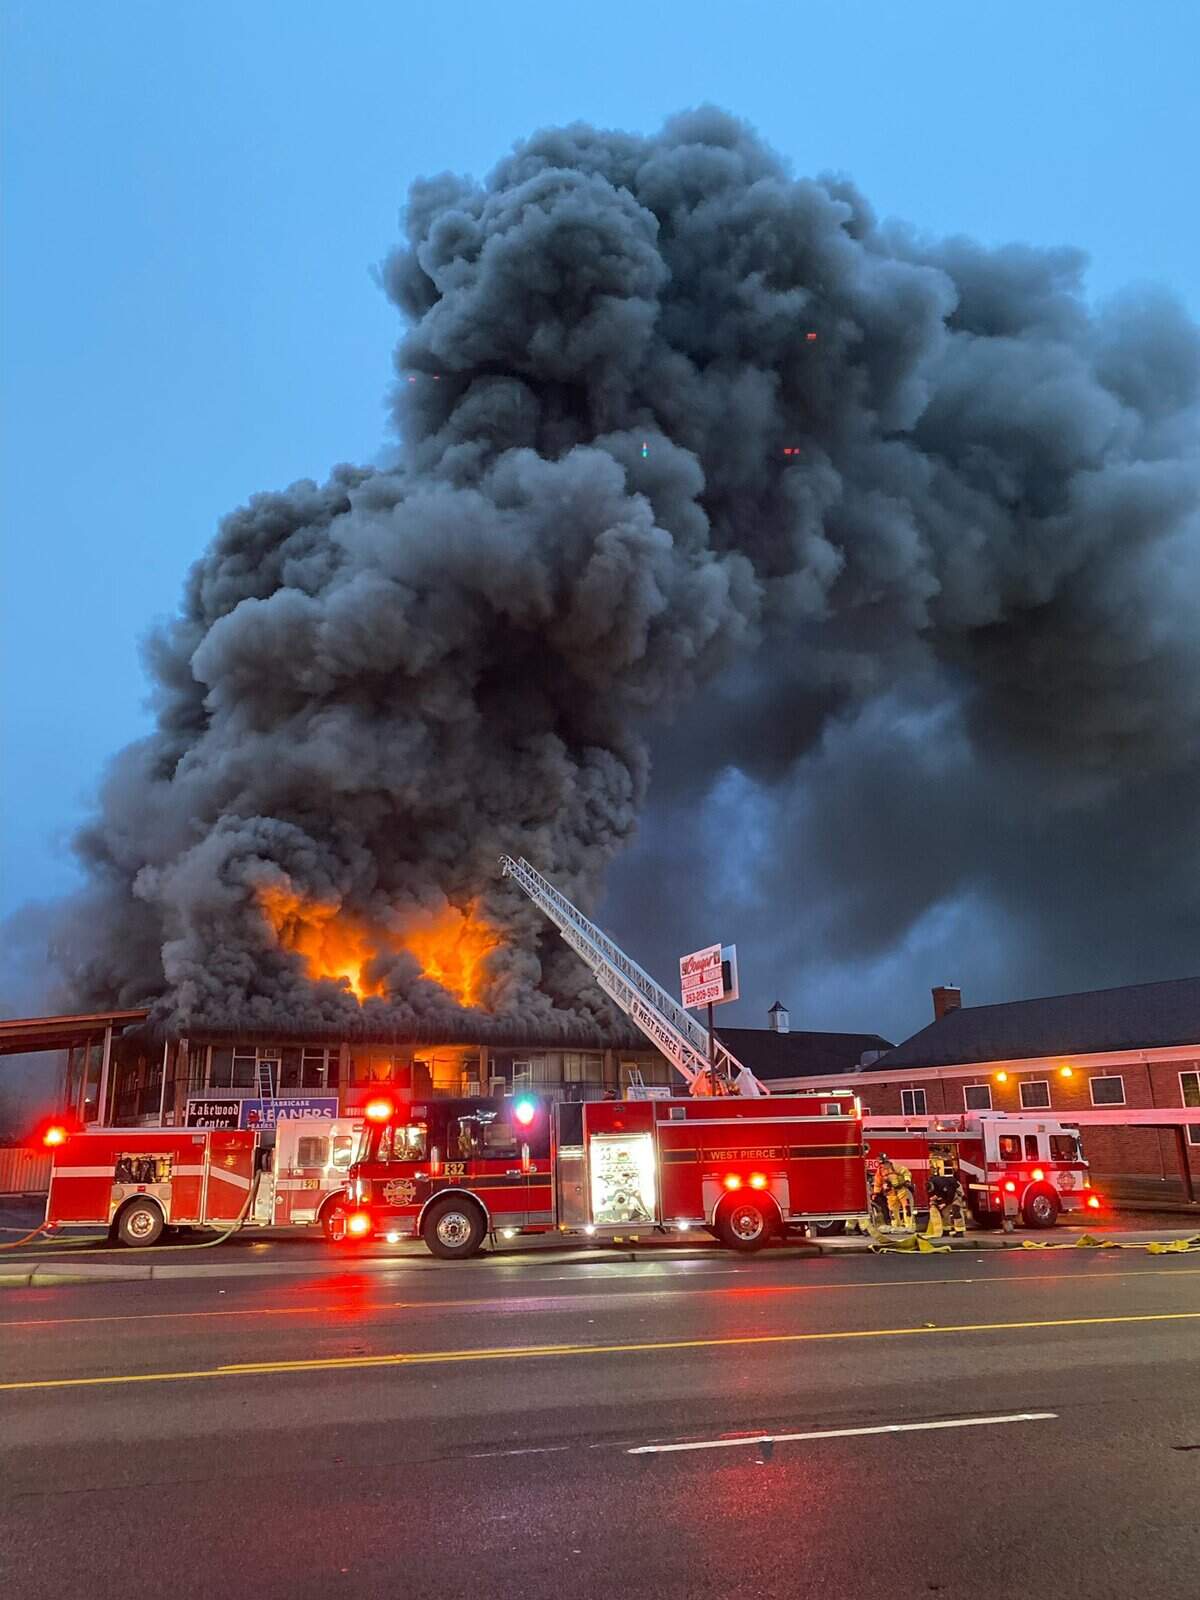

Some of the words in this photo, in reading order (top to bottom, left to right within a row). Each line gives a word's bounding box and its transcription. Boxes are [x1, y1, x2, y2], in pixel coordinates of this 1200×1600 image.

[638, 1007, 655, 1030] WEST
[655, 1026, 677, 1055] PIERCE
[189, 1103, 239, 1116] Lakewood
[196, 1117, 230, 1128] Center
[710, 1150, 737, 1160] WEST
[740, 1149, 776, 1159] PIERCE
[445, 1163, 464, 1176] E32
